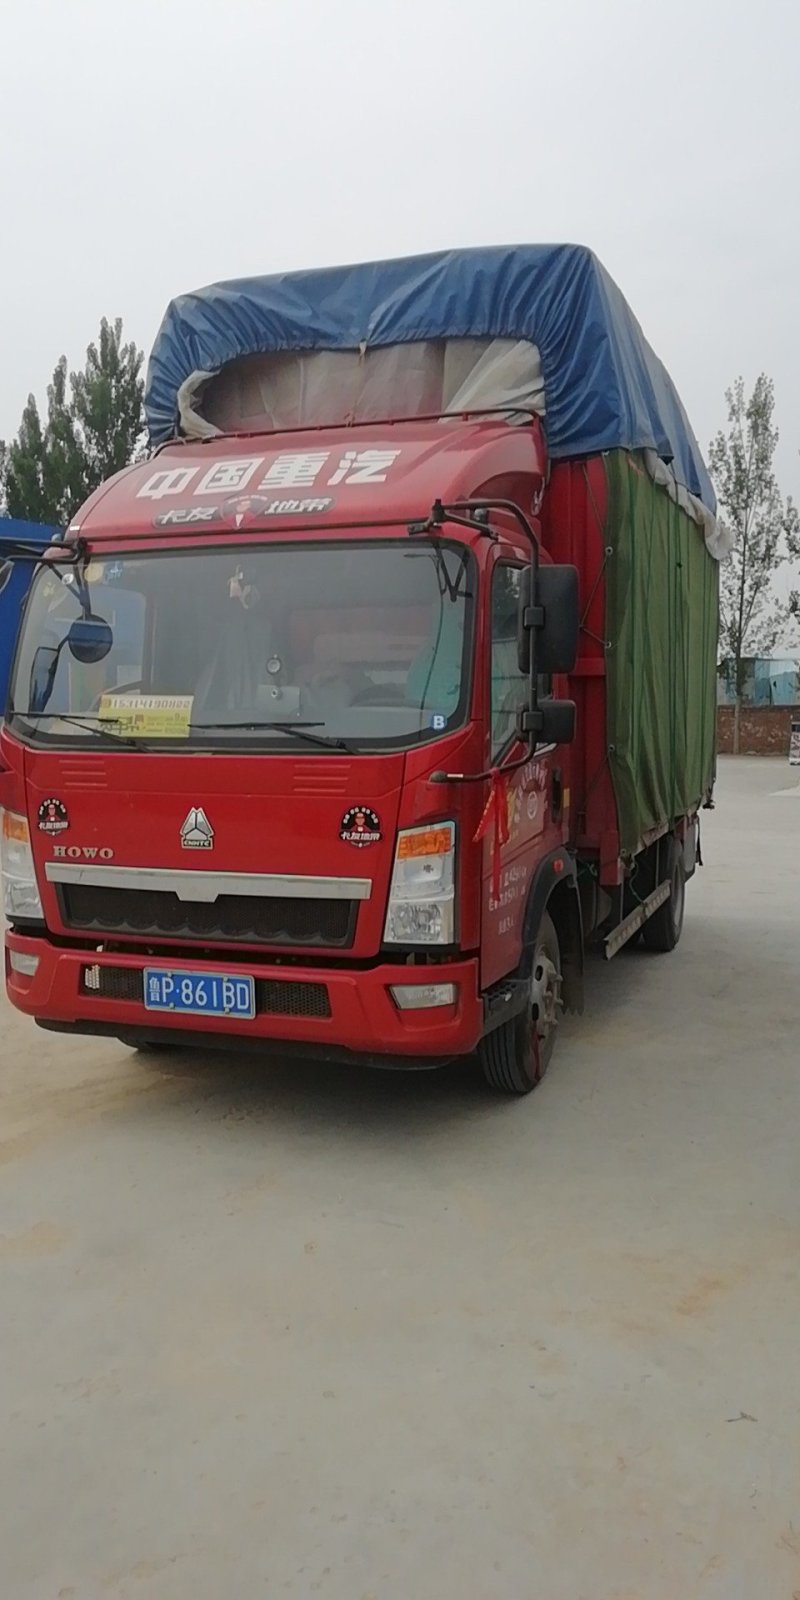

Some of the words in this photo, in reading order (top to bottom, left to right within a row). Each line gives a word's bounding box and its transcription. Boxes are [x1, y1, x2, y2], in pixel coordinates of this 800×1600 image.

[136, 450, 401, 500] 中国重汽
[158, 506, 219, 525] 卡友
[264, 497, 333, 515] 地带
[433, 715, 445, 730] B
[53, 846, 114, 860] HOWO
